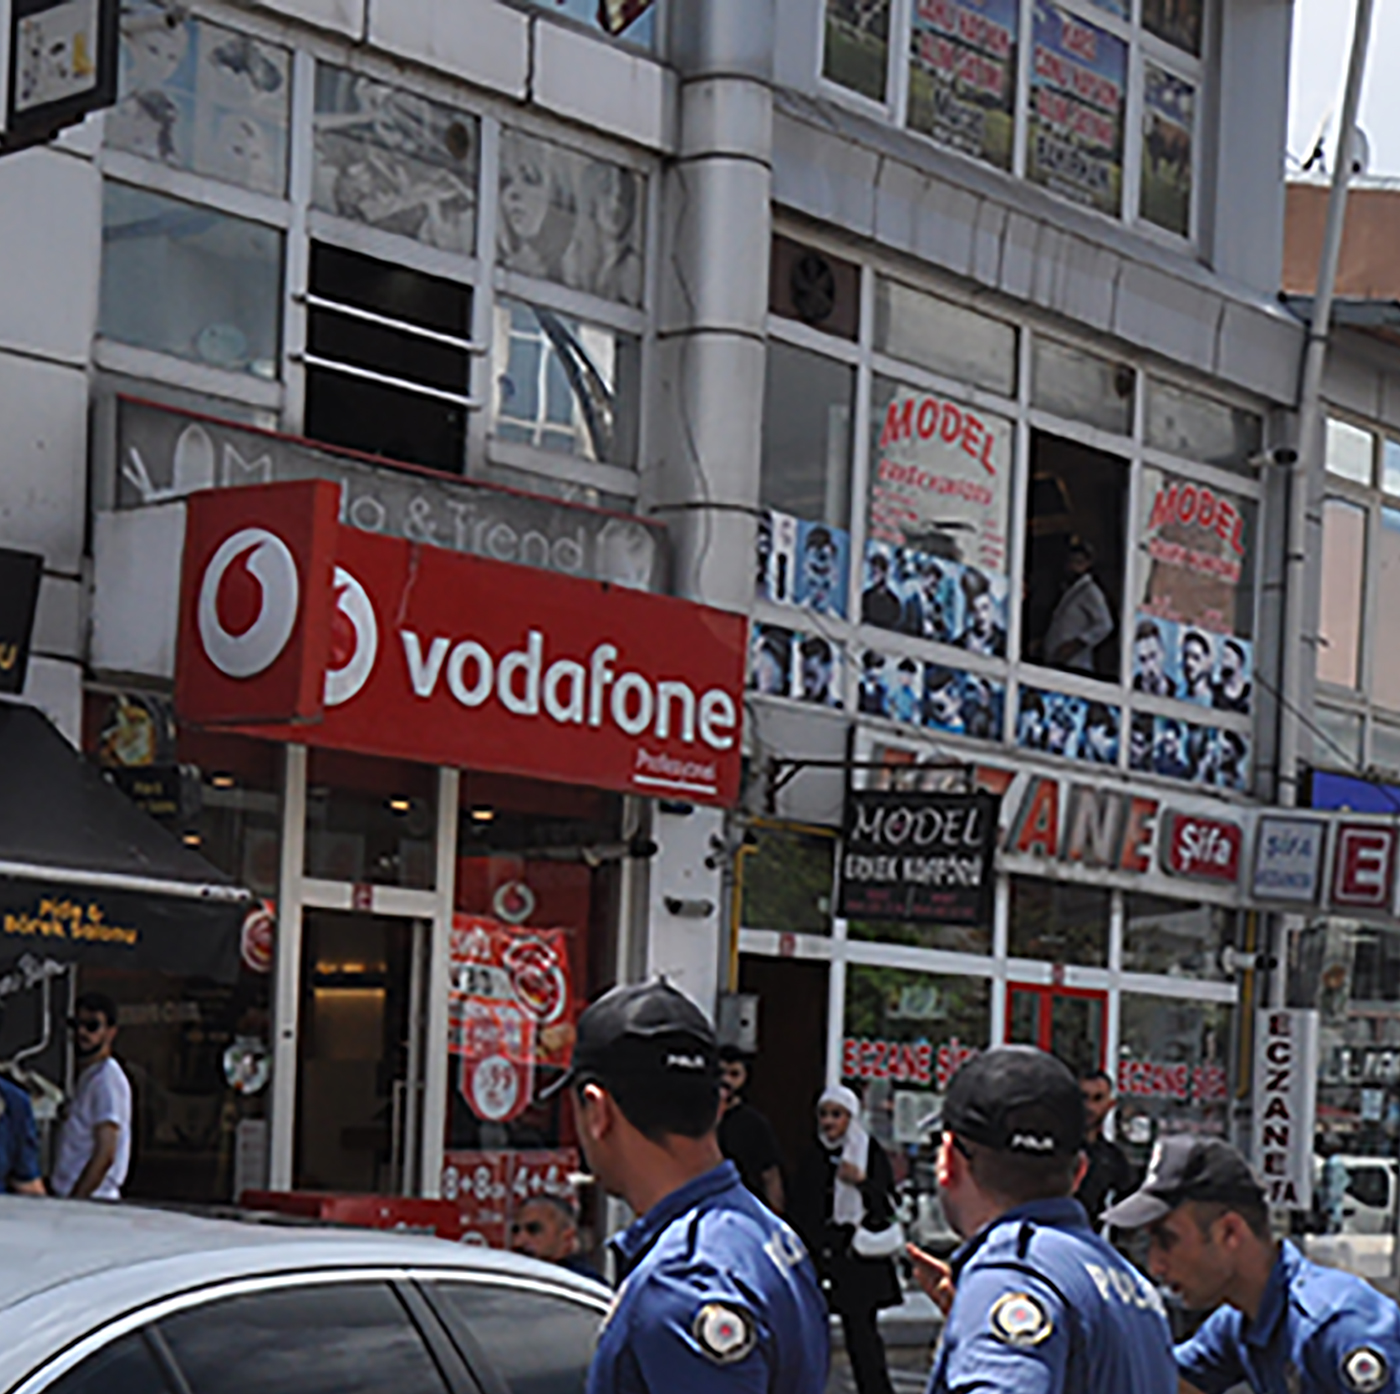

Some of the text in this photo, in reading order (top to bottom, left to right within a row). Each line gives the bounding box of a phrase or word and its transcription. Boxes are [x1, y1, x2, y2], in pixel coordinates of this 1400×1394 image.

[879, 397, 996, 477] MODEL
[408, 496, 438, 541] &
[447, 500, 586, 570] Trend
[1148, 484, 1245, 556] MODEL
[400, 630, 737, 749] vodafone
[851, 803, 984, 847] MODEL
[843, 1038, 932, 1083] ECZANE
